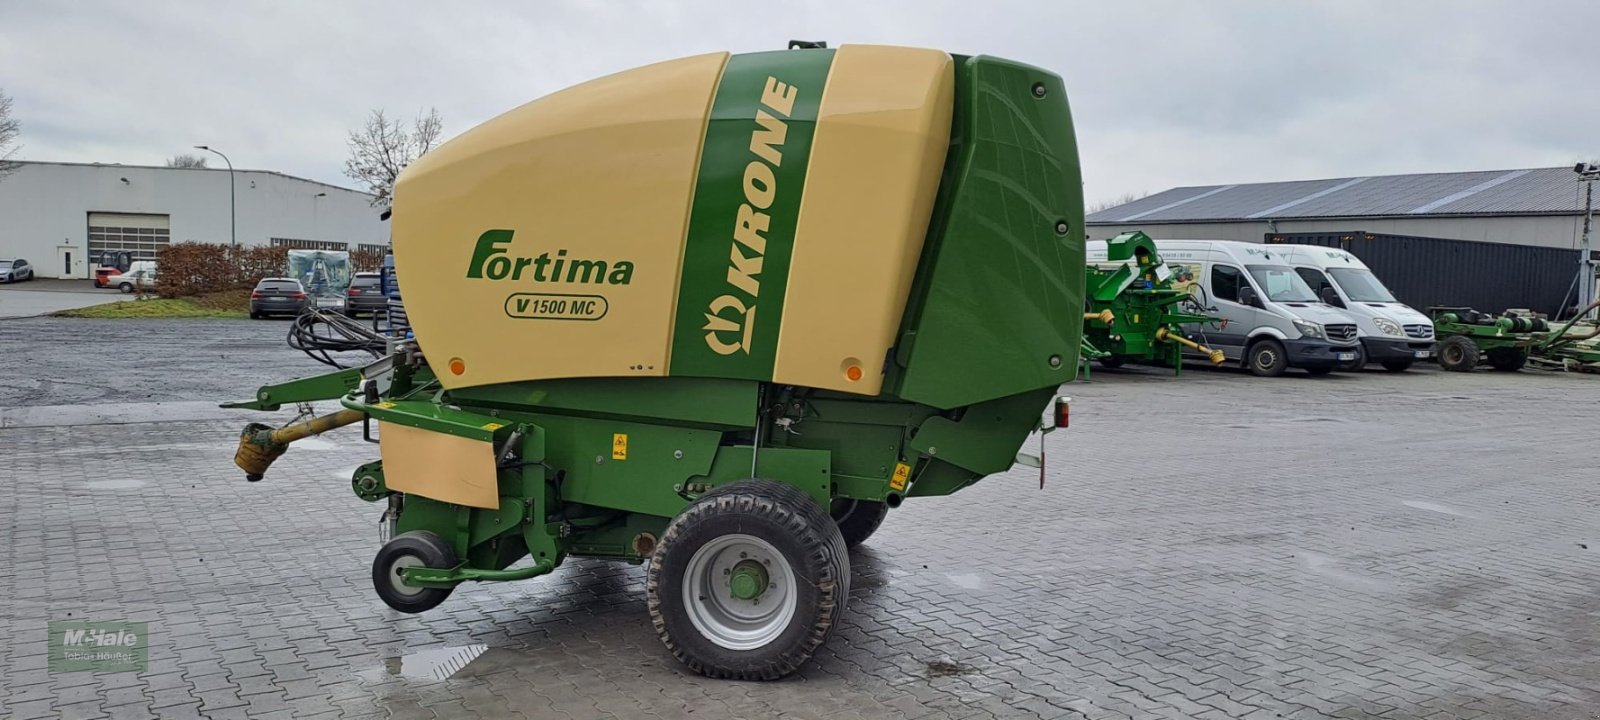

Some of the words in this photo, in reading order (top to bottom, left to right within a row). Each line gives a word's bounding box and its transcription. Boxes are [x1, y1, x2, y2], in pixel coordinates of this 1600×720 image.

[726, 75, 798, 298] KRONE
[466, 229, 634, 285] Fortima
[516, 298, 530, 313] V
[533, 299, 567, 314] 1500
[570, 300, 597, 315] MC
